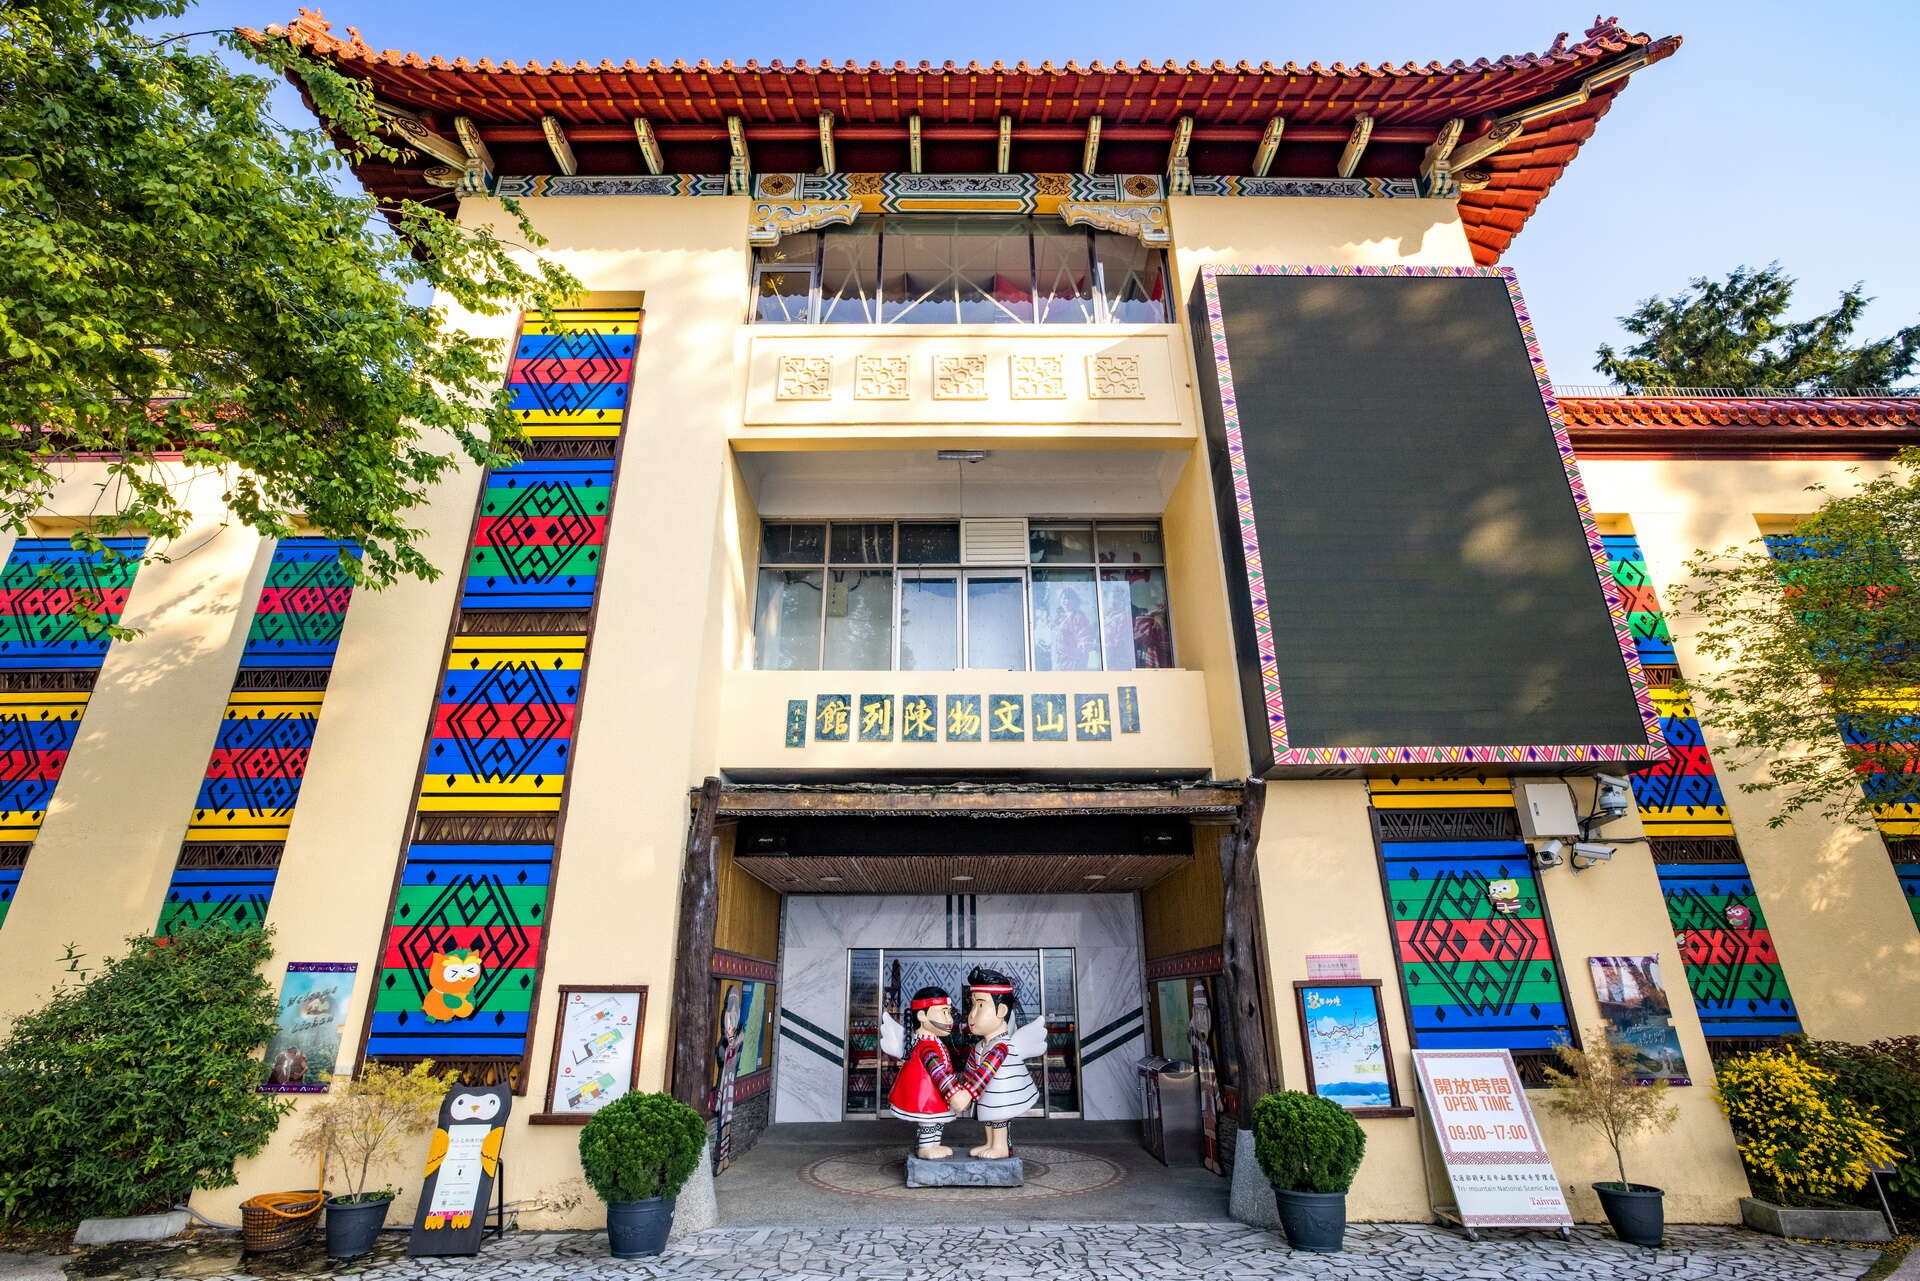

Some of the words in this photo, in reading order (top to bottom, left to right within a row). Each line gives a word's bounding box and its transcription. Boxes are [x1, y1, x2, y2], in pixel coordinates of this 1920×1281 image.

[816, 699, 1111, 737] 梨山文物陳列館
[1433, 1078, 1512, 1095] 開放時間
[1443, 1095, 1478, 1112] OPEN
[1482, 1095, 1514, 1112] TIME
[1448, 1125, 1528, 1141] 09:00~17:00
[1529, 1196, 1561, 1206] Taiwan
